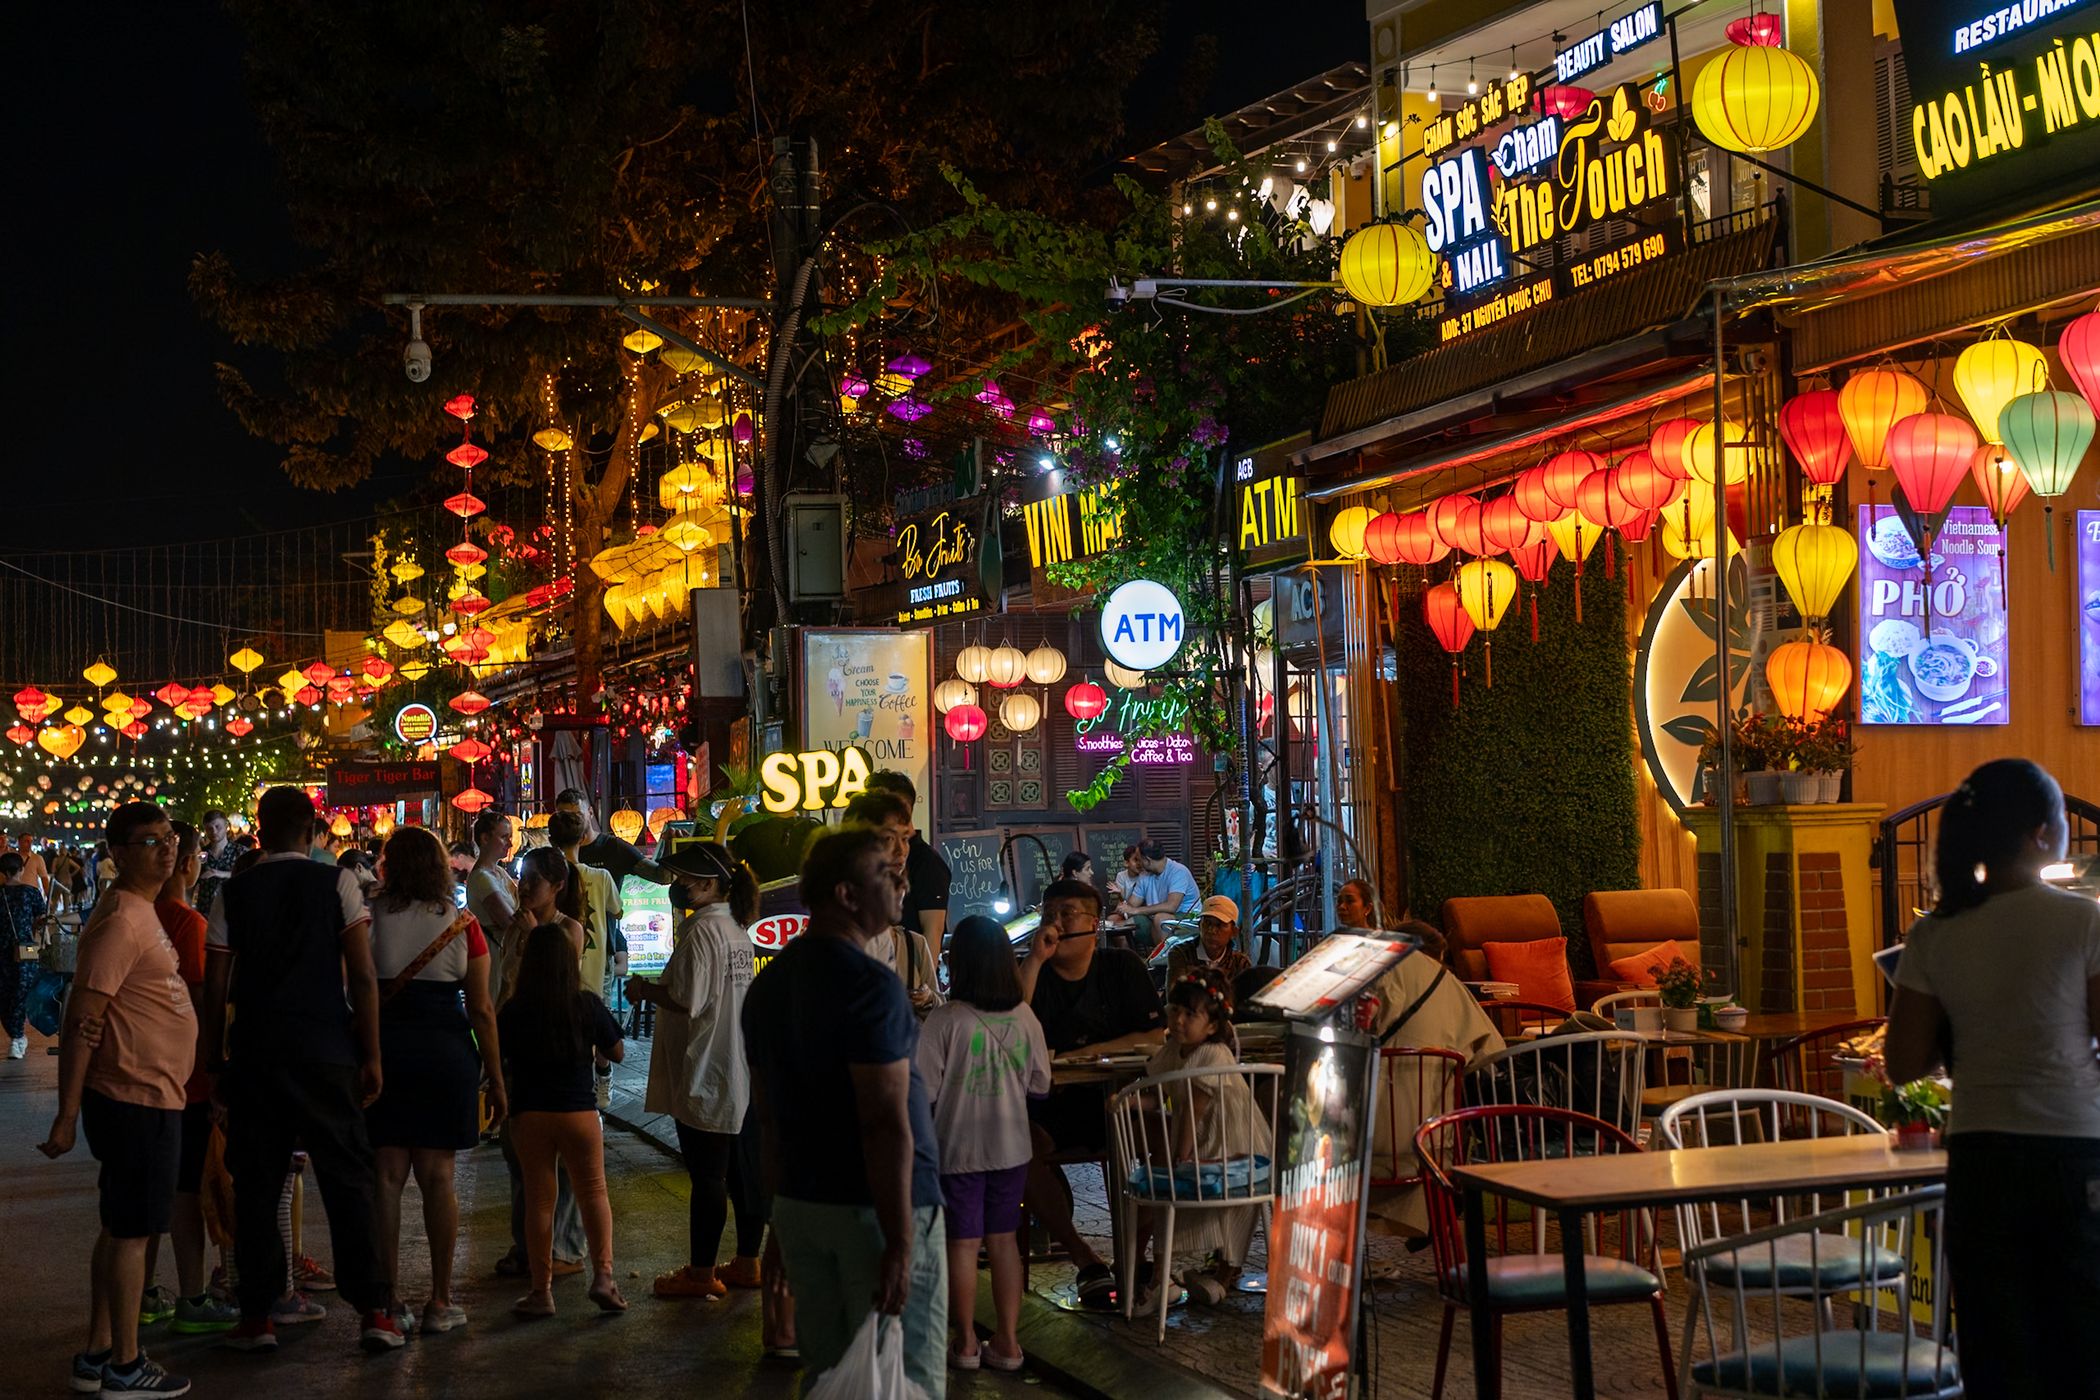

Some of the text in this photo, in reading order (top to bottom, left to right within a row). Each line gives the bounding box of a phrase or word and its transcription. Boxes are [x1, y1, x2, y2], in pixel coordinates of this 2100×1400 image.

[1557, 4, 1657, 82] BEAUTY SALON
[1456, 101, 1478, 139] SÓC
[1481, 82, 1503, 125] SẮC
[1912, 92, 1970, 179] CAO
[1965, 62, 2024, 160] LẦU
[2036, 38, 2079, 134] MÌ
[1505, 97, 1668, 254] The Touch
[1422, 151, 1484, 253] SPA
[1456, 238, 1503, 293] NAIL
[1571, 233, 1665, 288] TEL: 0794 579 690
[1461, 313, 1472, 333] 37
[1533, 279, 1552, 306] CHU
[1237, 457, 1254, 482] ACB
[1024, 493, 1073, 568] VINI
[1240, 475, 1298, 550] ATM
[1942, 519, 2001, 536] Vietnamese
[1941, 539, 2001, 557] Noodle Soup
[910, 579, 960, 603] FRESH FRUITS
[1871, 566, 1967, 617] PHỞ
[1114, 613, 1182, 643] ATM
[838, 659, 874, 677] Cream
[856, 679, 880, 687] CHOOSE
[861, 688, 877, 697] YOUR
[845, 698, 878, 707] HAPPINESS
[878, 694, 918, 712] Coffee
[336, 768, 435, 787] Tiger Tiger Bar
[761, 746, 871, 813] SPA
[1131, 749, 1193, 763] Coffee & Tea
[949, 874, 1000, 900] coffee
[1281, 1157, 1326, 1213] HAPPY
[1291, 1223, 1318, 1272] BUY
[1320, 1230, 1328, 1278] 1
